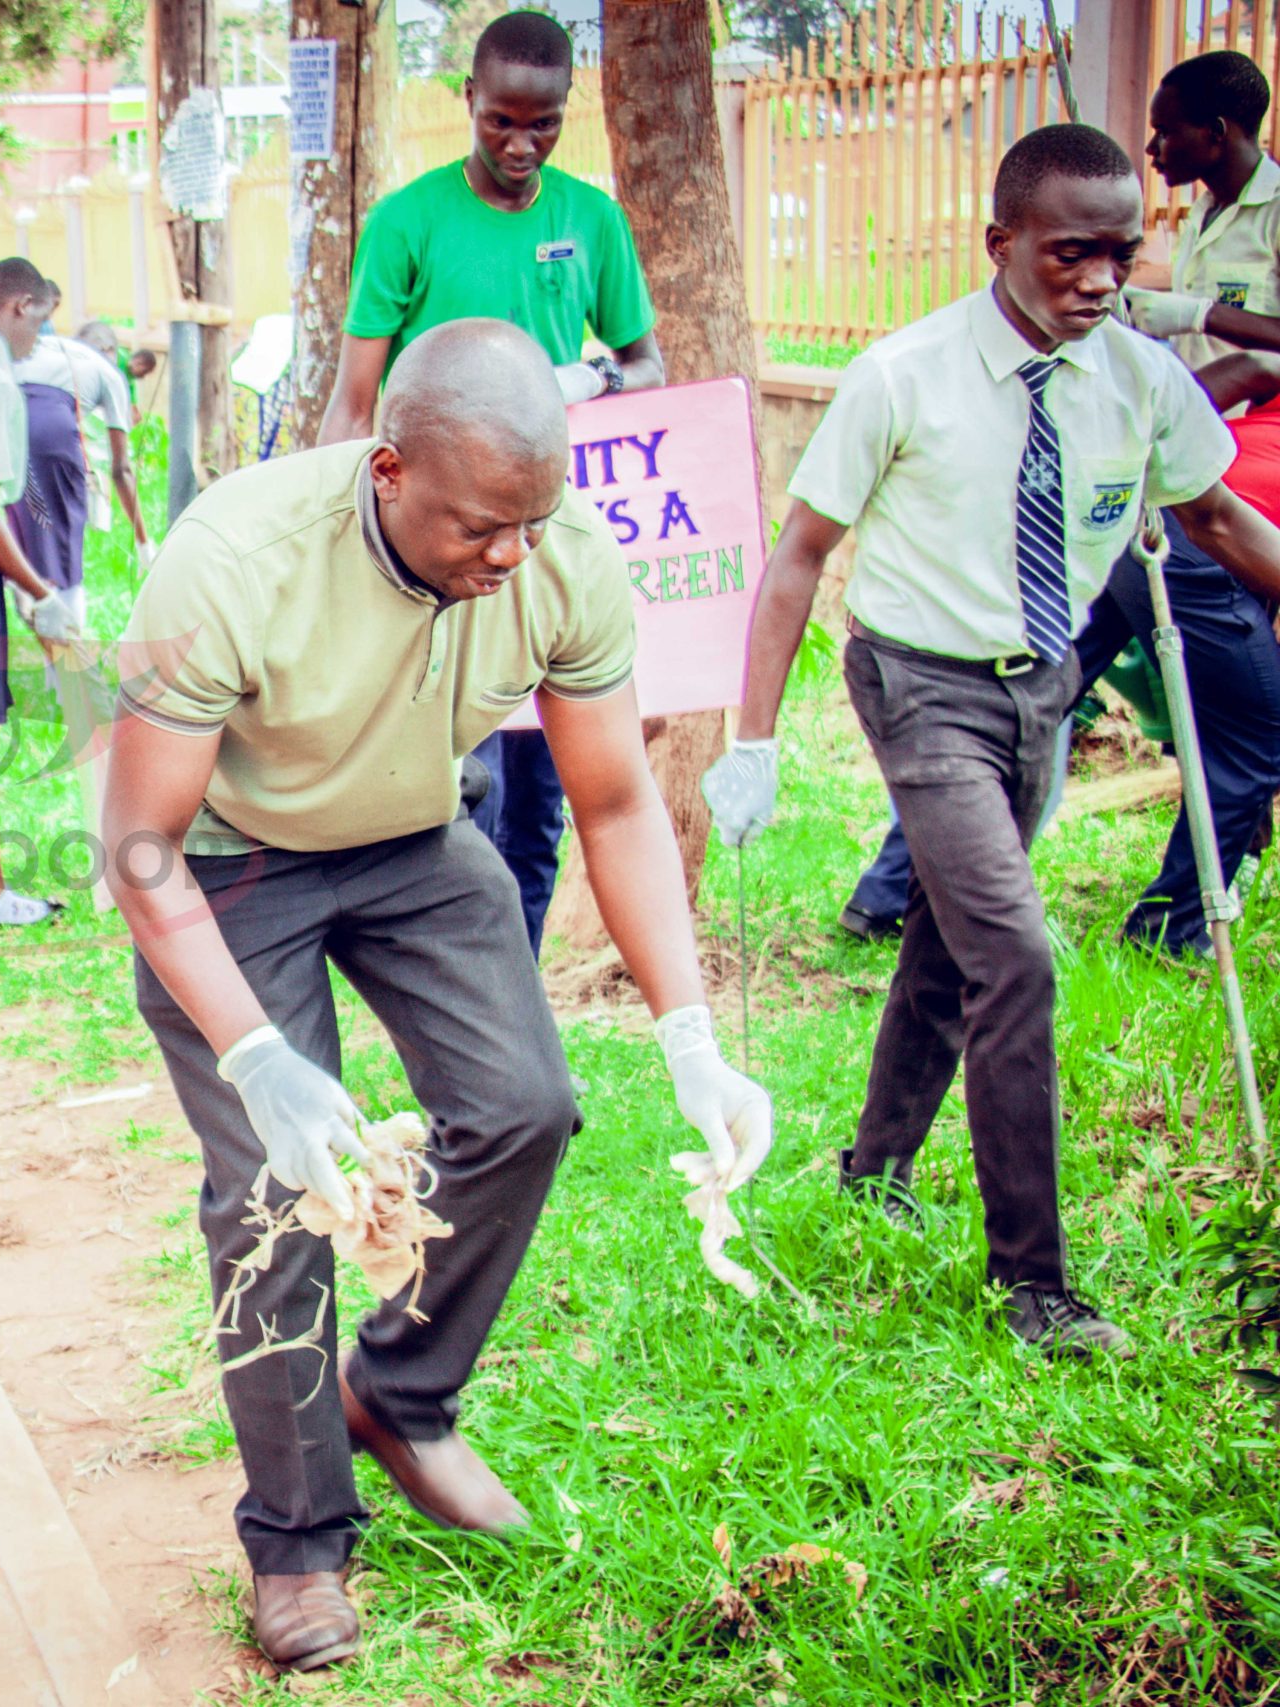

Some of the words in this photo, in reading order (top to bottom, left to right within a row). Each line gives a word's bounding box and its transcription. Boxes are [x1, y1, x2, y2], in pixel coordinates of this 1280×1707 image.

[566, 428, 669, 491] ITY
[594, 499, 640, 545] S
[658, 491, 701, 541] A
